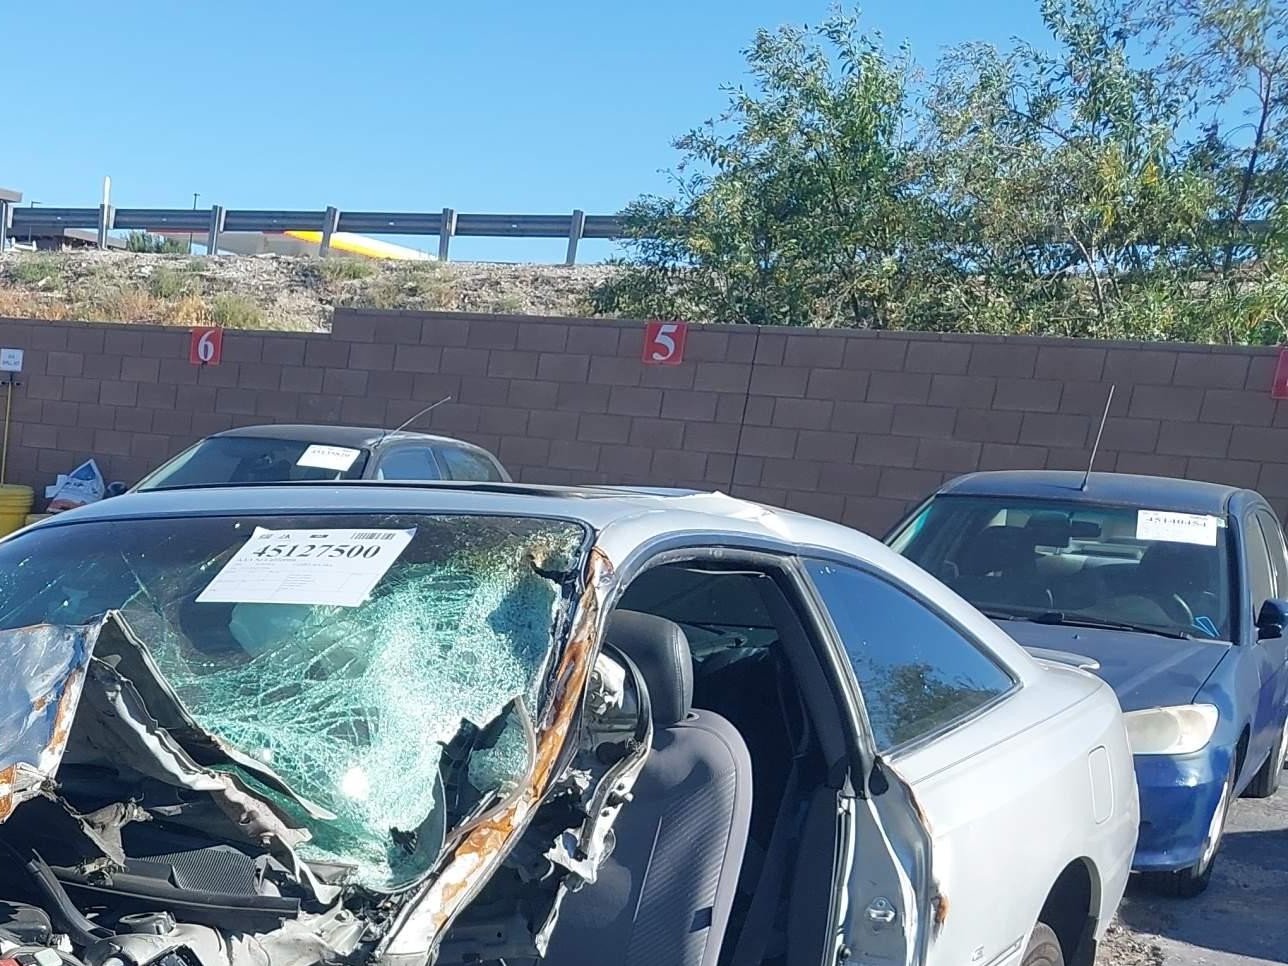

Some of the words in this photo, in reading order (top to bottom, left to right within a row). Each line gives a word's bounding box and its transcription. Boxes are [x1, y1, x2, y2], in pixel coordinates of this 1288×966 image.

[198, 330, 213, 361] 6
[652, 324, 678, 360] 5
[253, 544, 381, 559] 45127500
